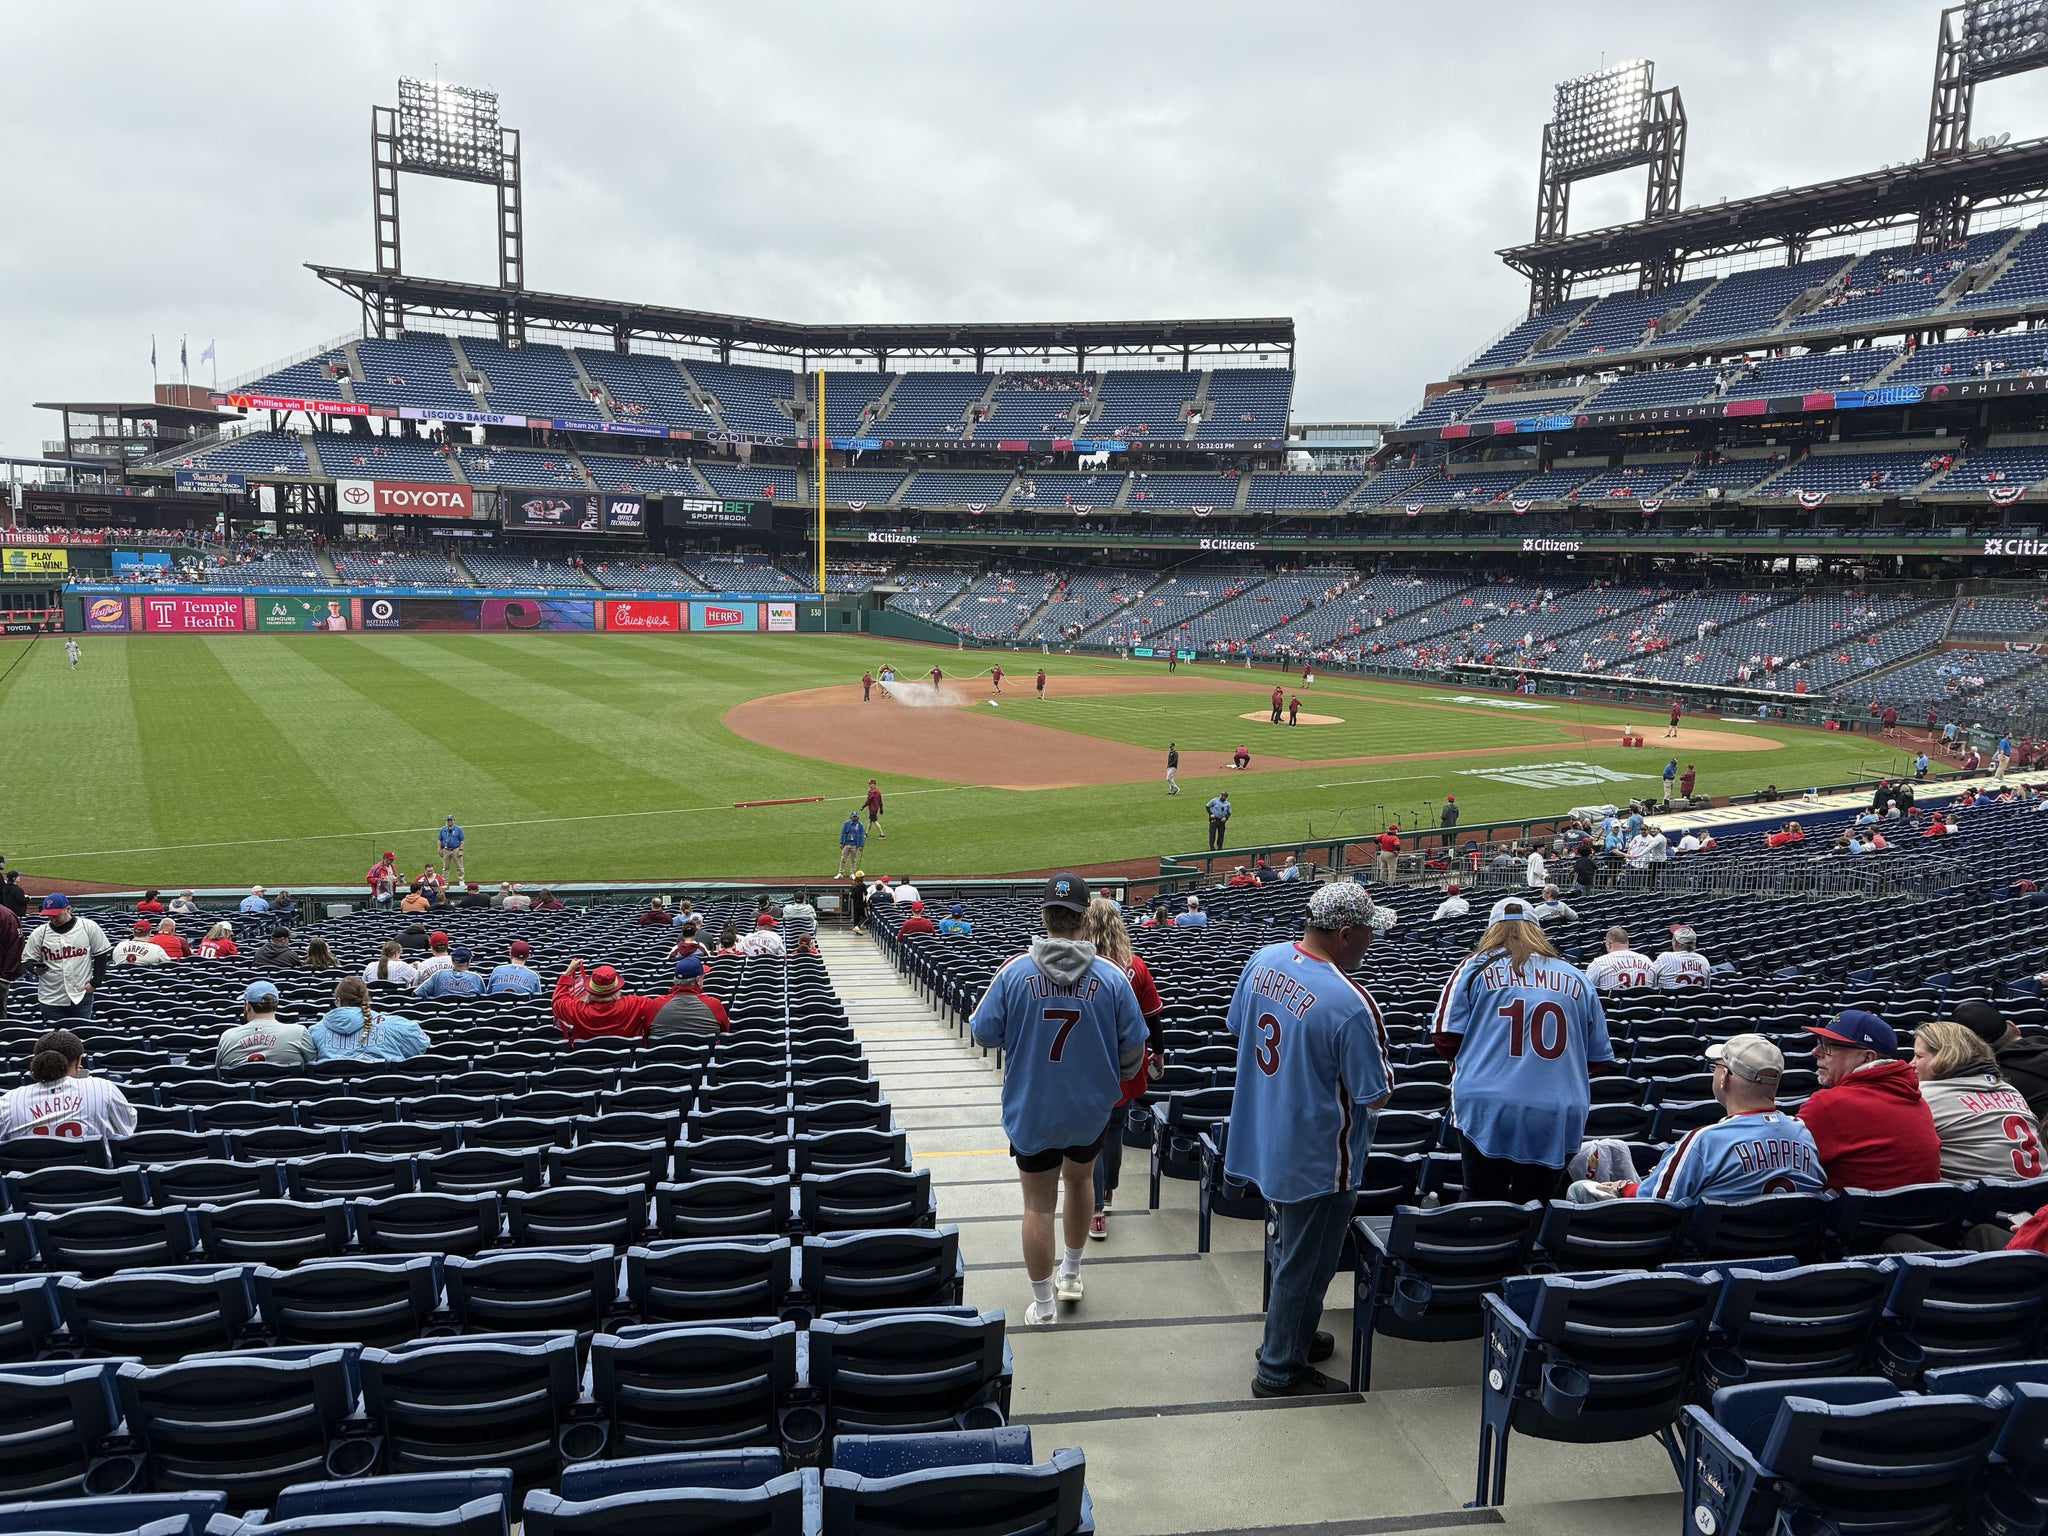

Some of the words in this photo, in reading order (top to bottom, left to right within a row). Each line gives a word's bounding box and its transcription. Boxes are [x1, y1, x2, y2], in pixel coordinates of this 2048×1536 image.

[253, 399, 283, 409] Phillies
[318, 404, 340, 412] Deals
[422, 410, 464, 421] LISCIO'S
[466, 413, 505, 423] BAKERY
[1598, 406, 1728, 423] PHILADELPHIA
[564, 421, 587, 429] Stream
[707, 432, 784, 446] CADILLAC
[380, 489, 465, 508] TOYOTA
[611, 502, 640, 514] KDI
[682, 499, 723, 512] ESPN
[724, 501, 755, 514] BET
[691, 513, 747, 521] SPORTSBOOK
[878, 533, 918, 543] Citizens
[1211, 539, 1256, 550] Citizens
[1534, 539, 1580, 551] Citizens
[2004, 539, 2048, 555] Citiz
[42, 561, 62, 569] WIN!
[120, 562, 156, 570] Independence
[91, 602, 122, 618] Hatfield
[182, 601, 237, 615] Temple
[183, 616, 235, 628] Health
[708, 611, 739, 622] HERR'S
[41, 946, 88, 963] Phillies
[123, 946, 149, 957] HARPER
[201, 946, 216, 958] 10
[1611, 959, 1651, 973] HALLADAY
[1681, 960, 1703, 974] KRUK
[499, 975, 528, 987] HARPER
[1483, 965, 1583, 1001] REALMUTO
[1618, 973, 1646, 989] 34
[1251, 966, 1316, 1021] HARPER
[1043, 1008, 1081, 1063] 7
[1498, 998, 1567, 1060] 10
[240, 1034, 277, 1049] HARPER
[1256, 1012, 1283, 1077] 3
[29, 1096, 83, 1119] MARSH
[2002, 1113, 2043, 1179] 3
[1734, 1138, 1811, 1174] HARPER
[1700, 1512, 1710, 1529] 34
